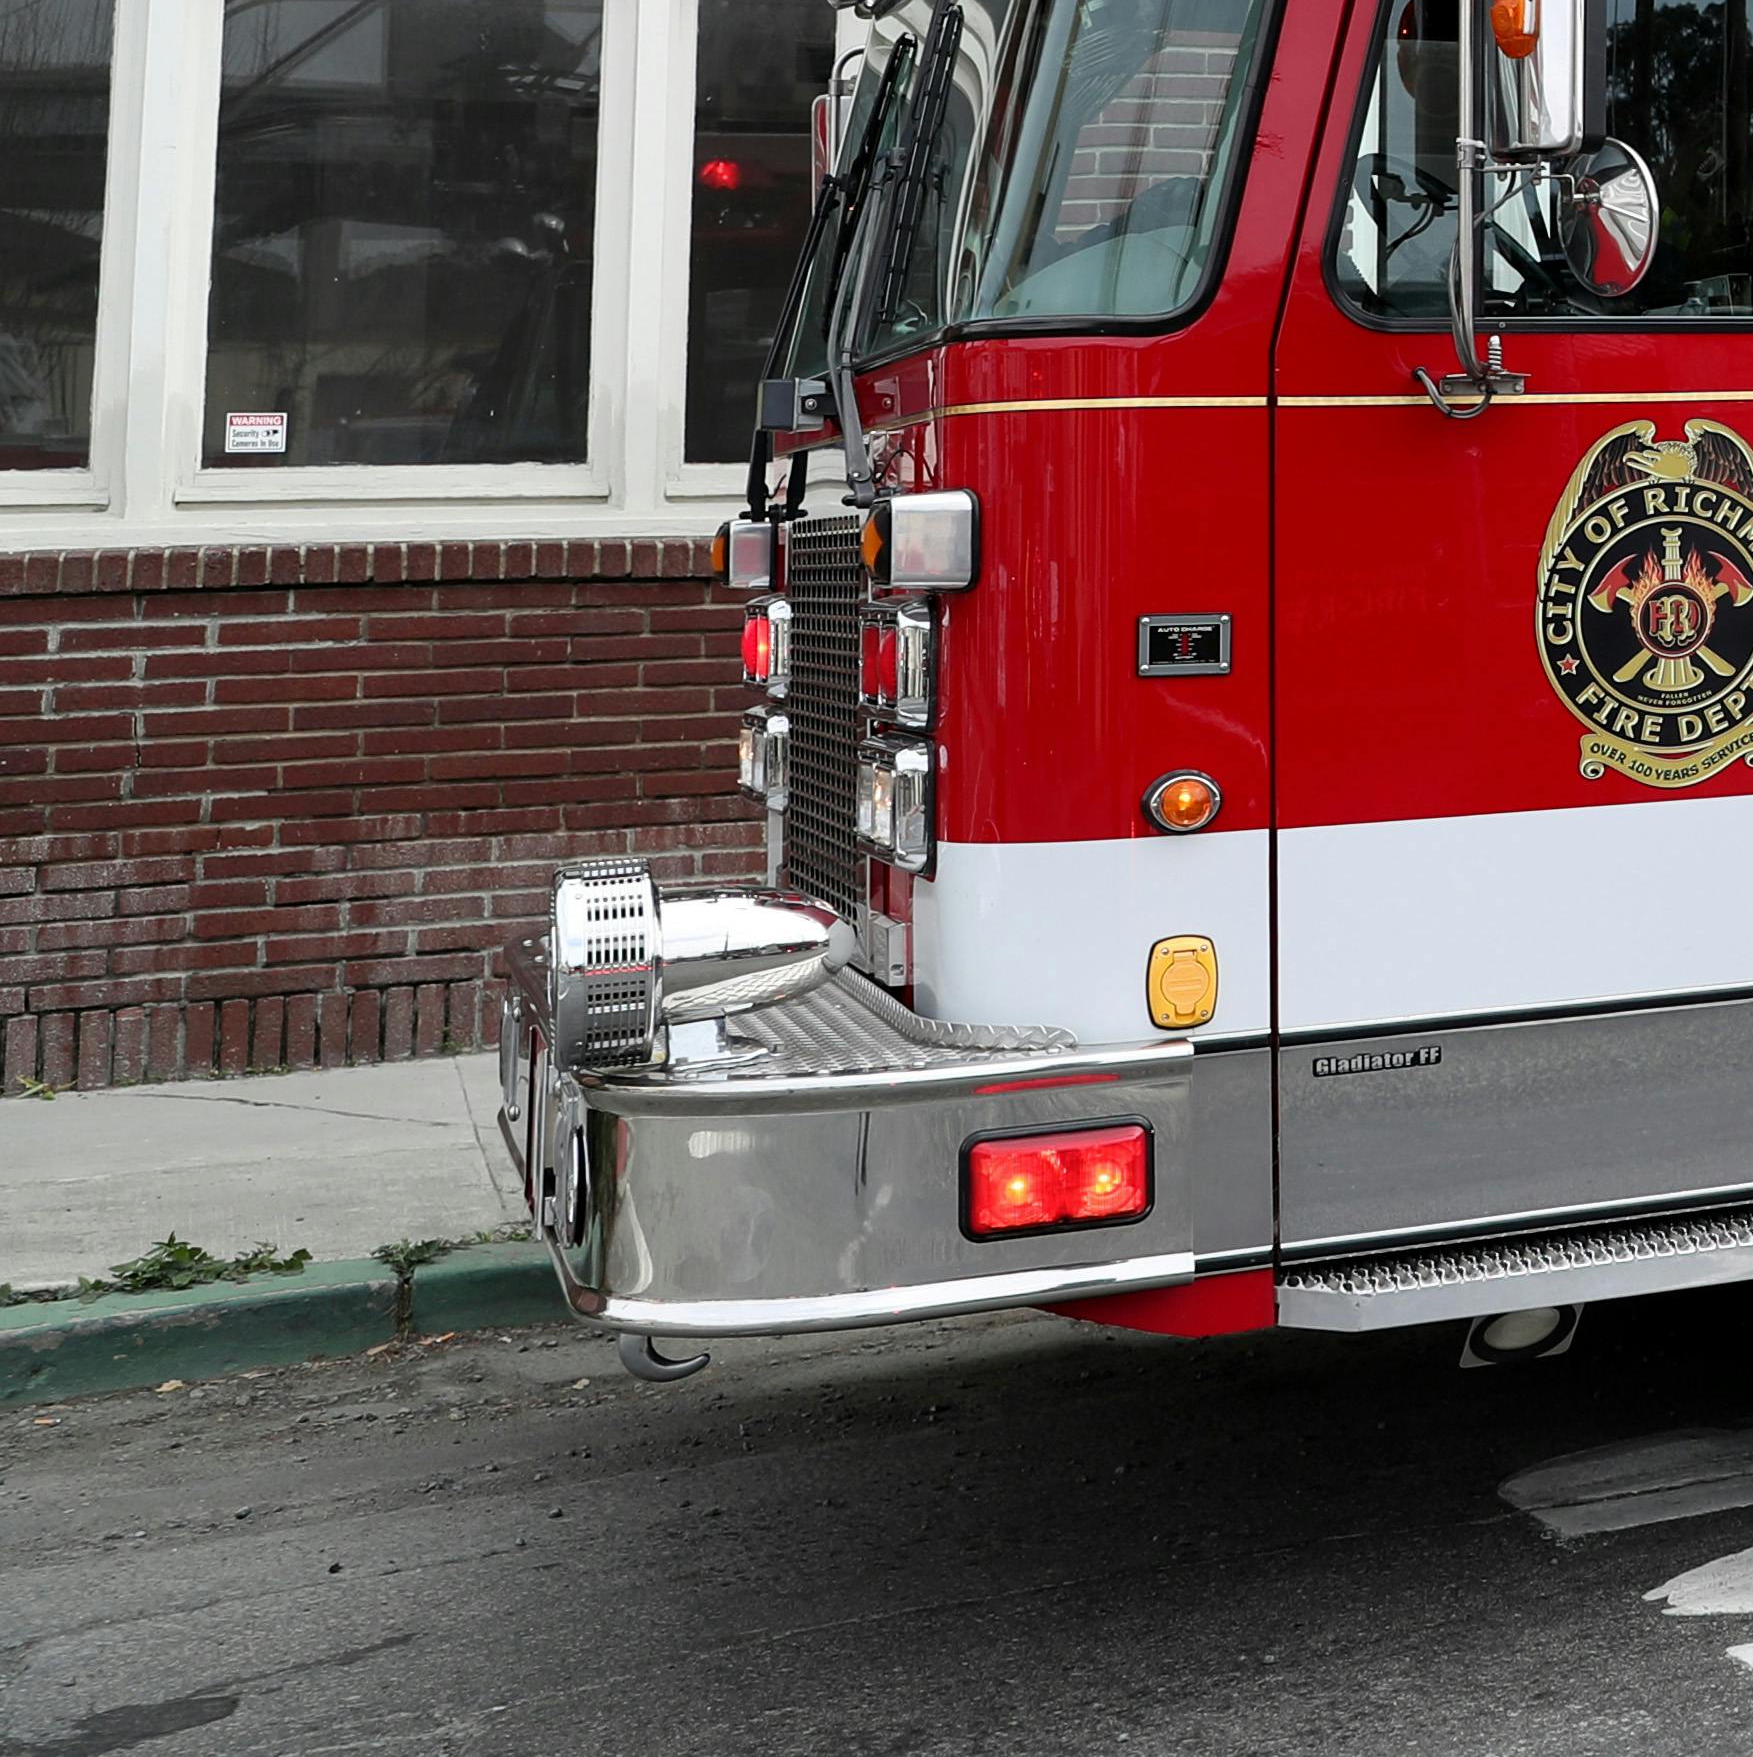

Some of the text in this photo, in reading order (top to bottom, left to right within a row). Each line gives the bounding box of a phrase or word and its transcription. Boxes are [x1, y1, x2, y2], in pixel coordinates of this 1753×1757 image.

[231, 416, 282, 425] WARNING
[232, 429, 259, 438] Security
[1546, 547, 1586, 646] CITY
[1583, 501, 1630, 544] OF
[1660, 692, 1690, 700] FALLEN
[1665, 689, 1713, 706] FORGOTTEN
[1575, 683, 1664, 744] FIRE
[1590, 742, 1627, 765] OVER
[1628, 759, 1653, 778] 100
[1654, 764, 1700, 781] YEARS
[1315, 1046, 1440, 1076] Gladiator FF
